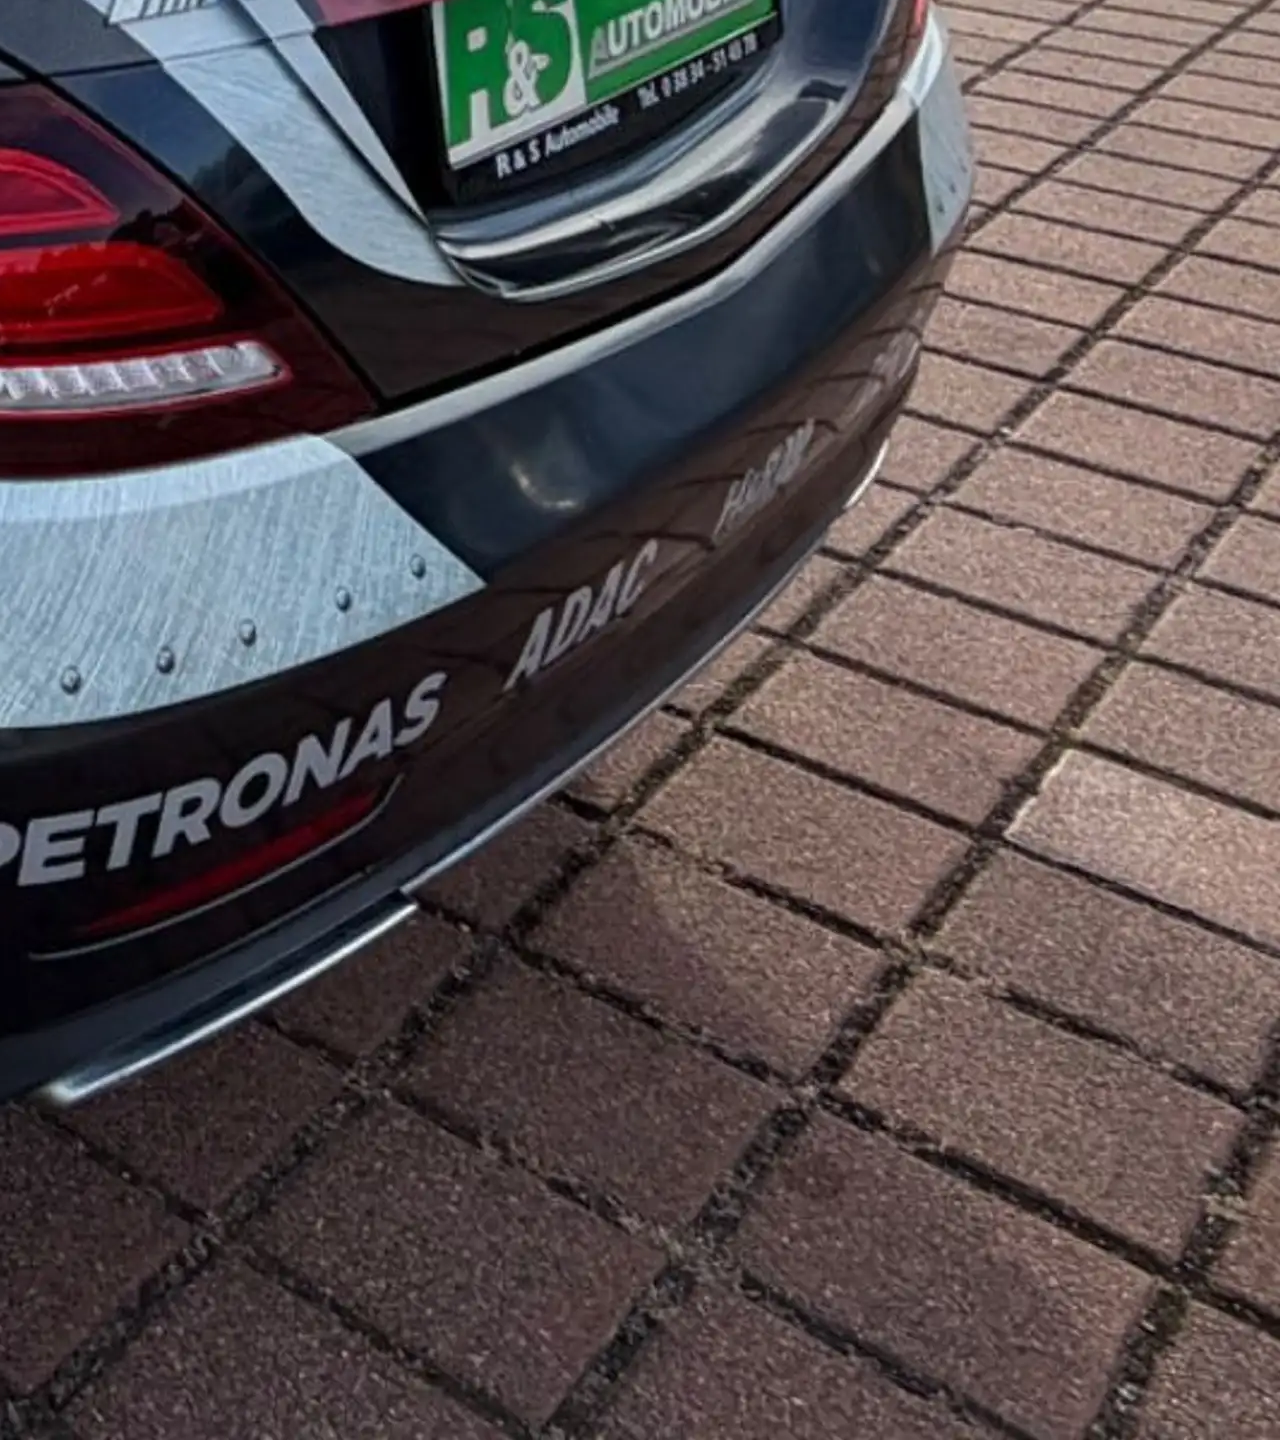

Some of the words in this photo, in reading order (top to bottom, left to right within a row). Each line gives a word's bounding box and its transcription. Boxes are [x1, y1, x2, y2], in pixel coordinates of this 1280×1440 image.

[495, 152, 513, 179] R
[528, 138, 541, 164] S
[544, 102, 620, 158] Automobile
[502, 538, 659, 692] ADAC
